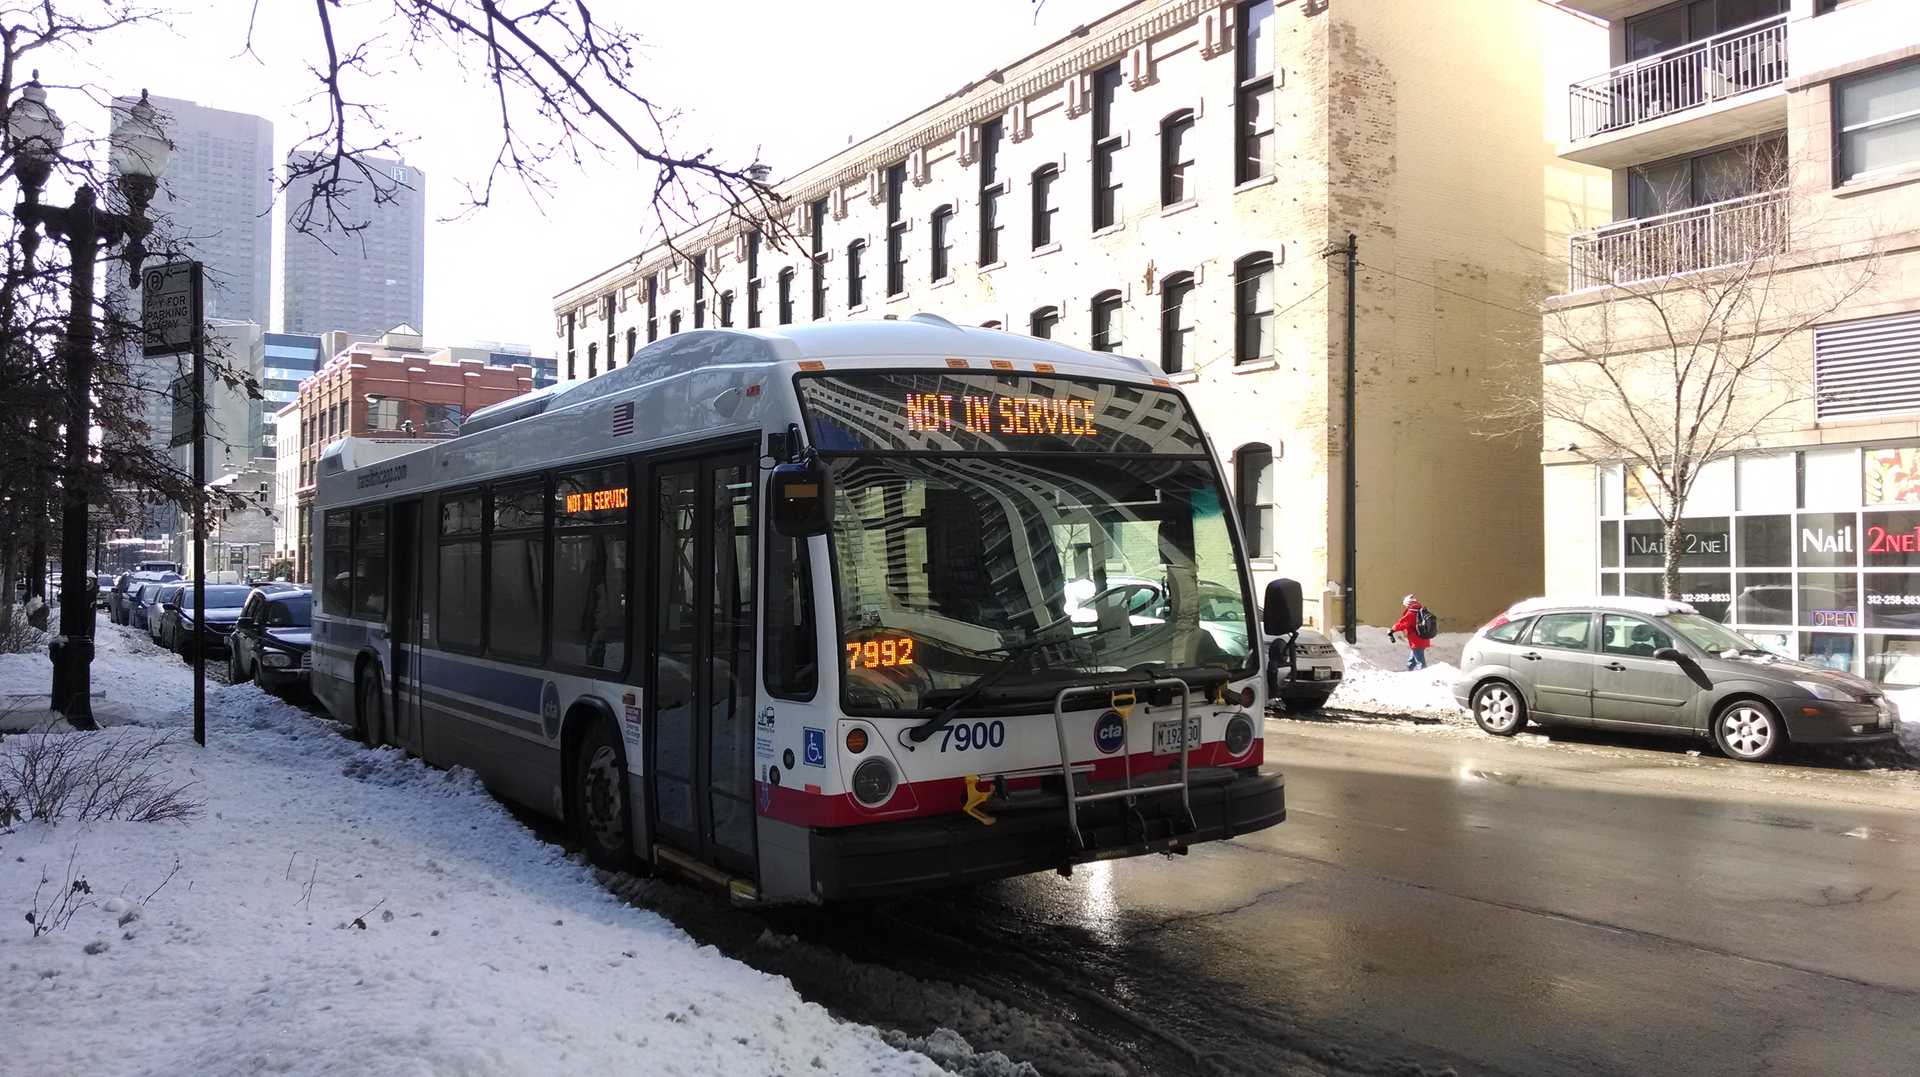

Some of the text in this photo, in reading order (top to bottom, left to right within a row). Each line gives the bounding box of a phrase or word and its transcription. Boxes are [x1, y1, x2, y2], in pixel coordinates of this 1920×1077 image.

[167, 295, 186, 307] FOR
[147, 306, 188, 321] PARKING
[147, 334, 162, 345] BO
[906, 393, 1098, 435] NOT IN SERVICE
[357, 464, 407, 489] transitchicago.com
[566, 494, 581, 513] NOT
[583, 492, 593, 511] IN
[1631, 535, 1667, 554] NAi
[1681, 593, 1731, 603] 312-258-8833
[1815, 612, 1857, 627] OPEN
[846, 638, 914, 670] 7992
[937, 720, 1005, 753] 7900
[1099, 724, 1122, 740] cta
[1166, 725, 1198, 745] 19230
